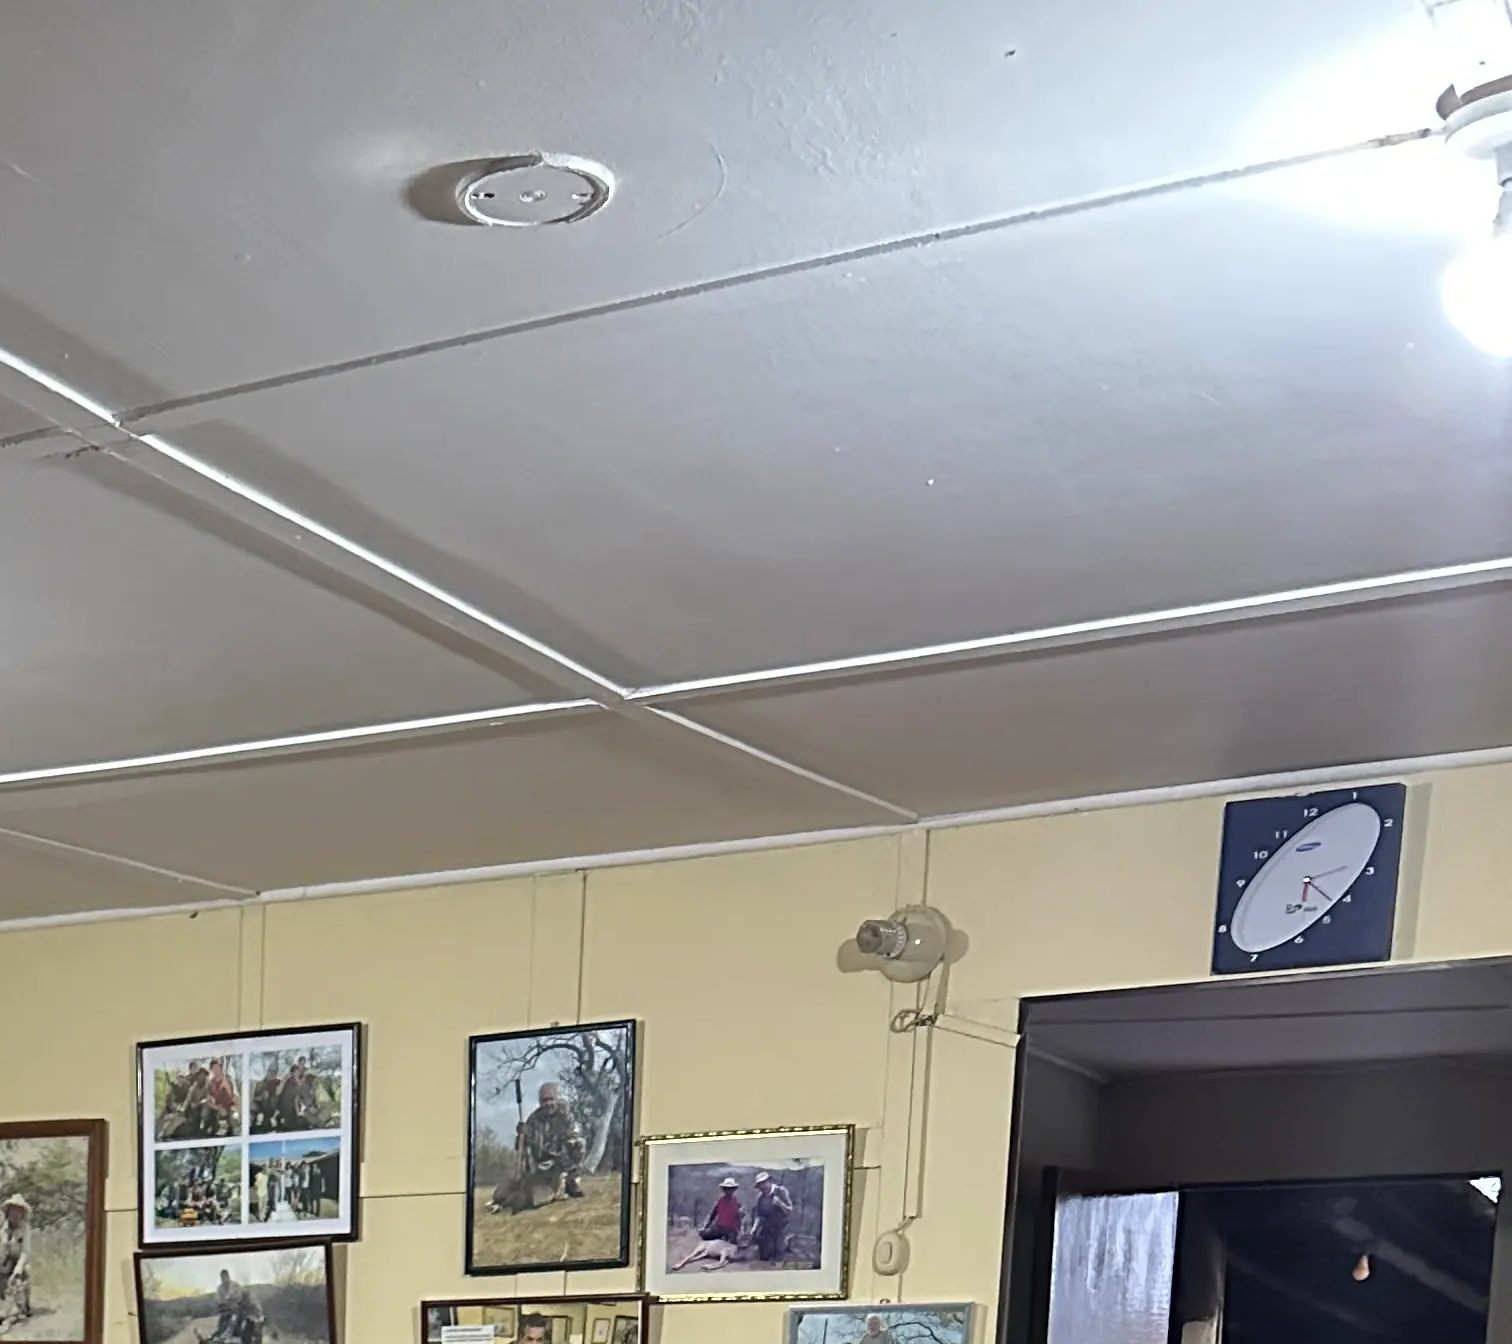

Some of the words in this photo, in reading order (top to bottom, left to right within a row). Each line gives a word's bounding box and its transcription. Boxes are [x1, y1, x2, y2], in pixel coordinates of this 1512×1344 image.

[1303, 808, 1319, 818] 12
[1384, 819, 1394, 828] 2
[1275, 830, 1288, 839] 11
[1253, 851, 1269, 860] 10
[1365, 866, 1375, 875] 3
[1236, 879, 1246, 888] 9
[1341, 894, 1352, 903] 4
[1322, 916, 1332, 925] 5
[1218, 924, 1227, 933] 8
[1294, 935, 1305, 944] 6
[1249, 954, 1259, 963] 7
